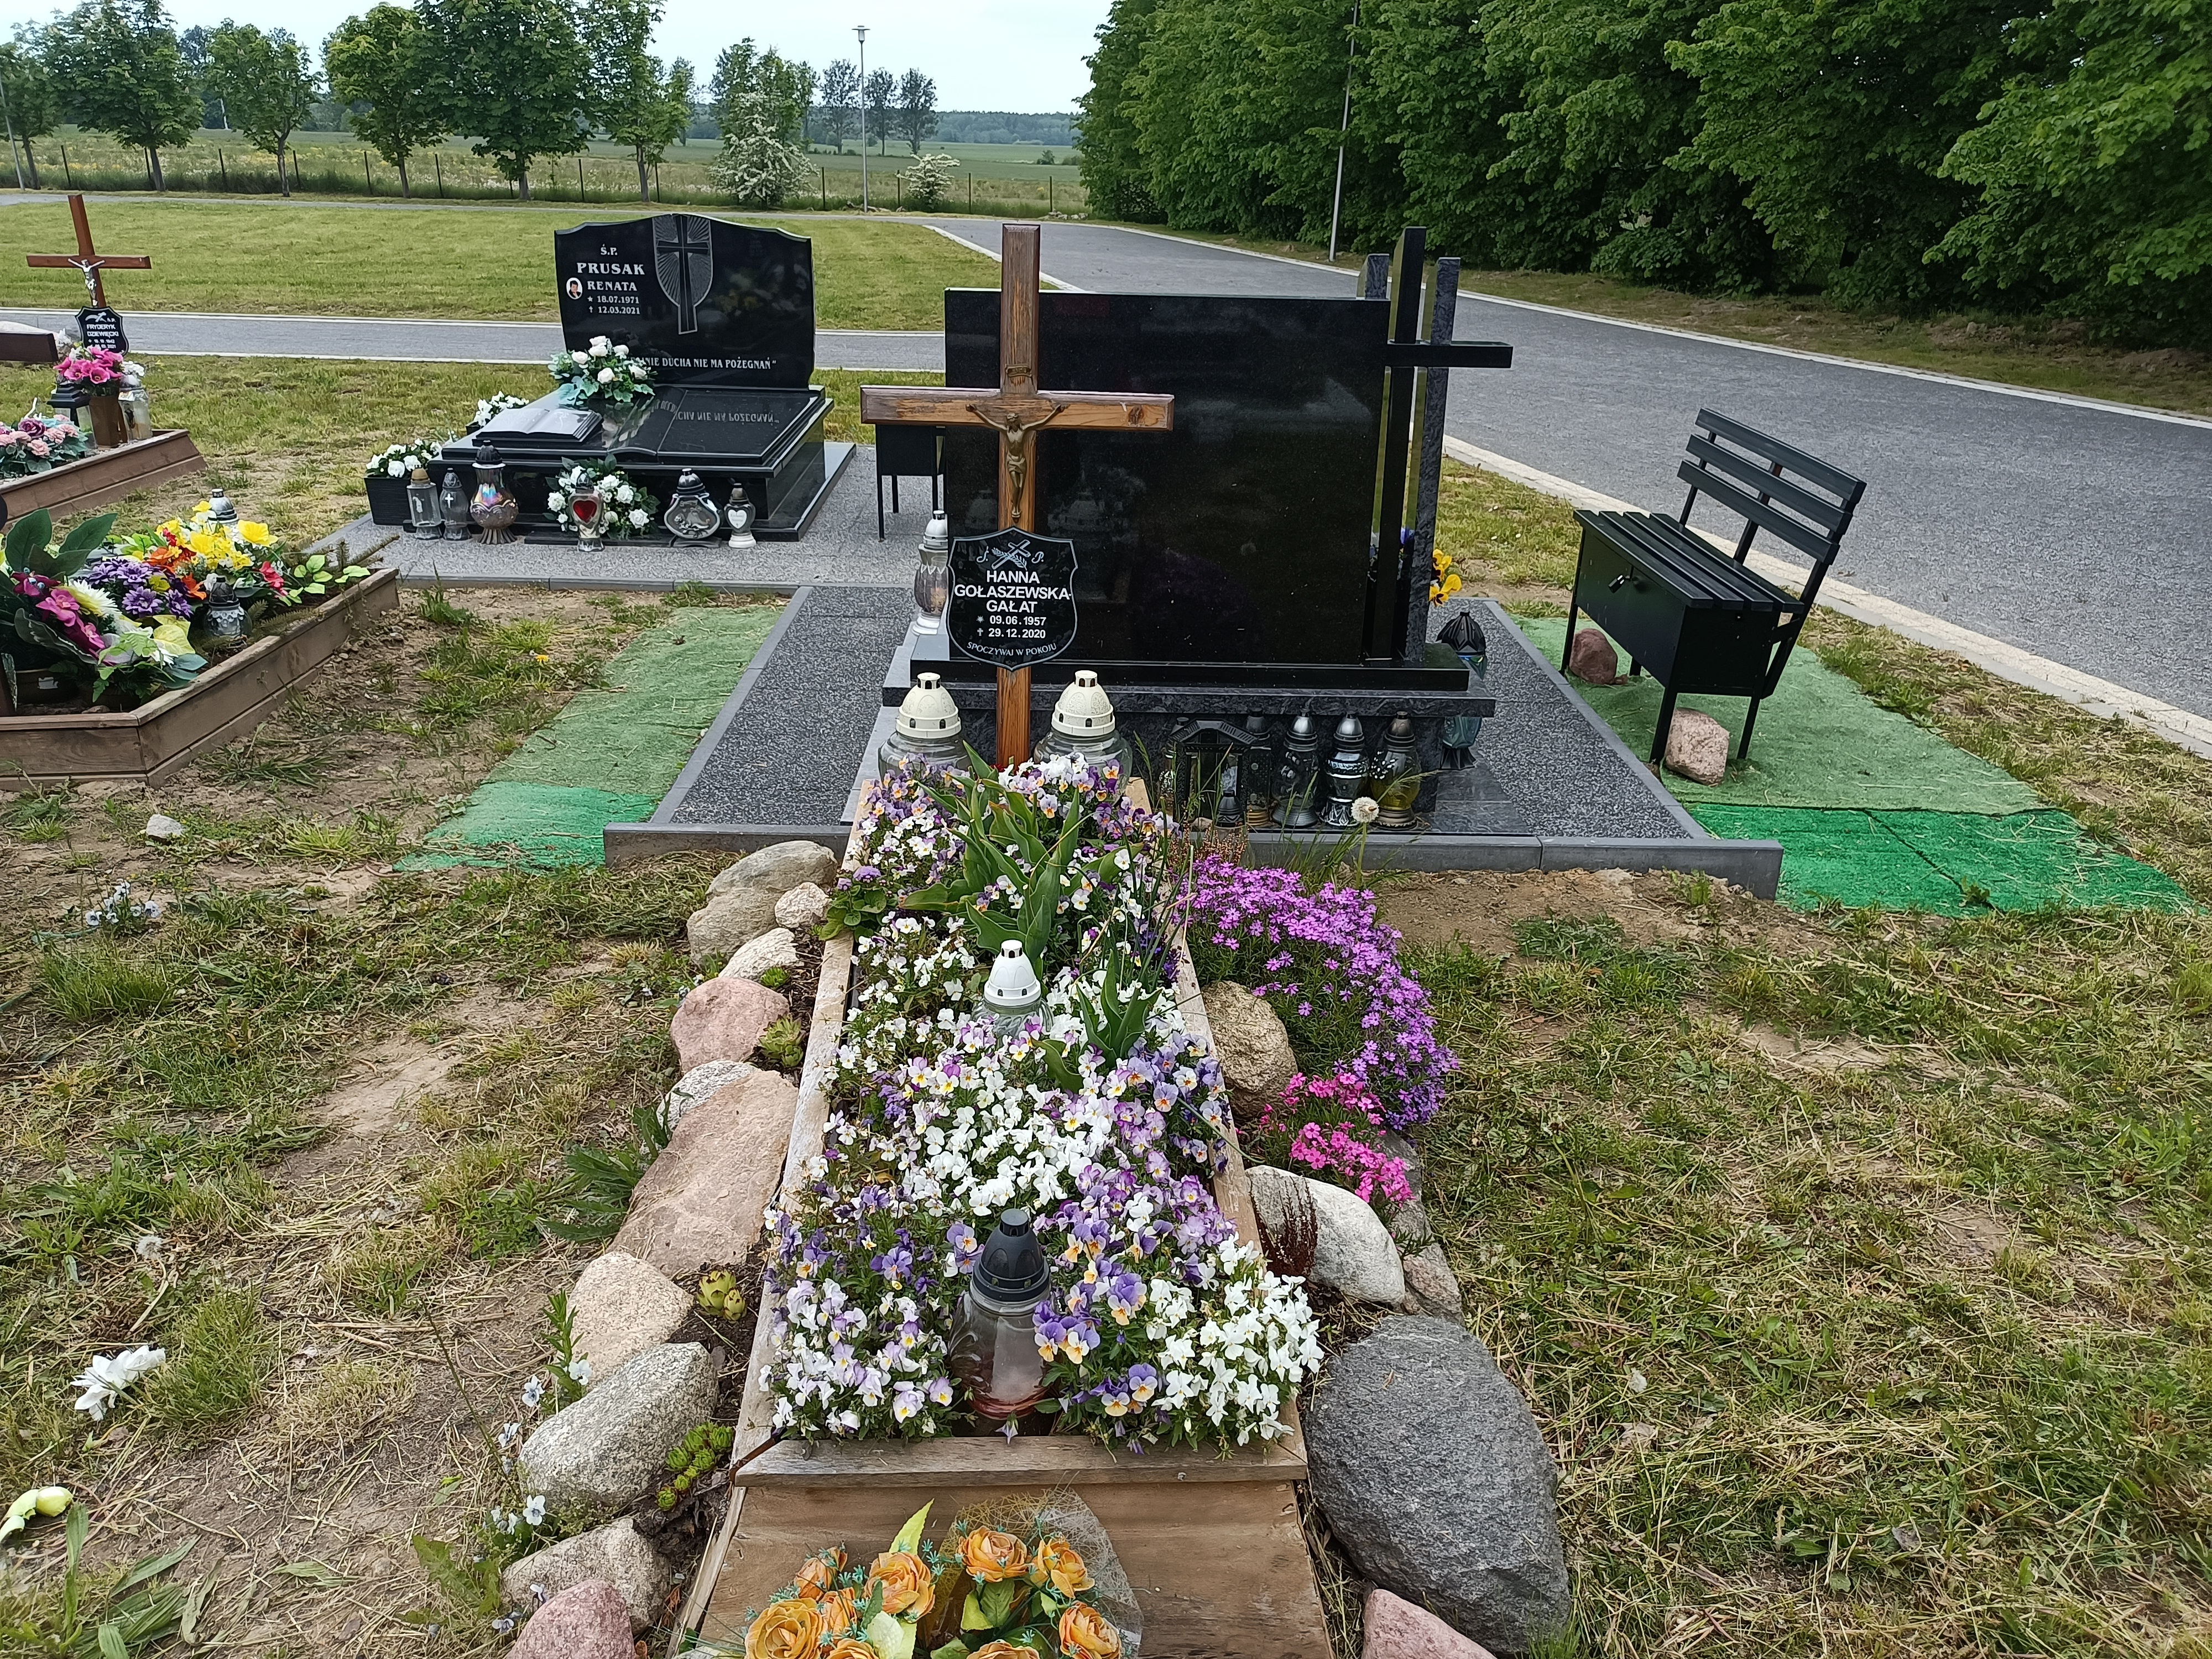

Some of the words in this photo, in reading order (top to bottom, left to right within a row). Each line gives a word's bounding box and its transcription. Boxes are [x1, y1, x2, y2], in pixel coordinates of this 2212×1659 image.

[601, 243, 618, 255] Ś.P.
[576, 262, 645, 275] PRUSAK
[587, 280, 638, 291] RENATA
[597, 295, 640, 304] 18.07.1971
[598, 306, 641, 315] 12.03.2021
[662, 357, 692, 367] DUCHA
[693, 358, 708, 368] NIE
[711, 359, 723, 368] MA
[986, 570, 1040, 584] HANNA
[954, 584, 1072, 600] GOŁASZEWSKA-
[986, 599, 1038, 613] GAŁAT
[967, 641, 1014, 656] SPOCZYWAJ
[1025, 642, 1057, 656] POKOJU
